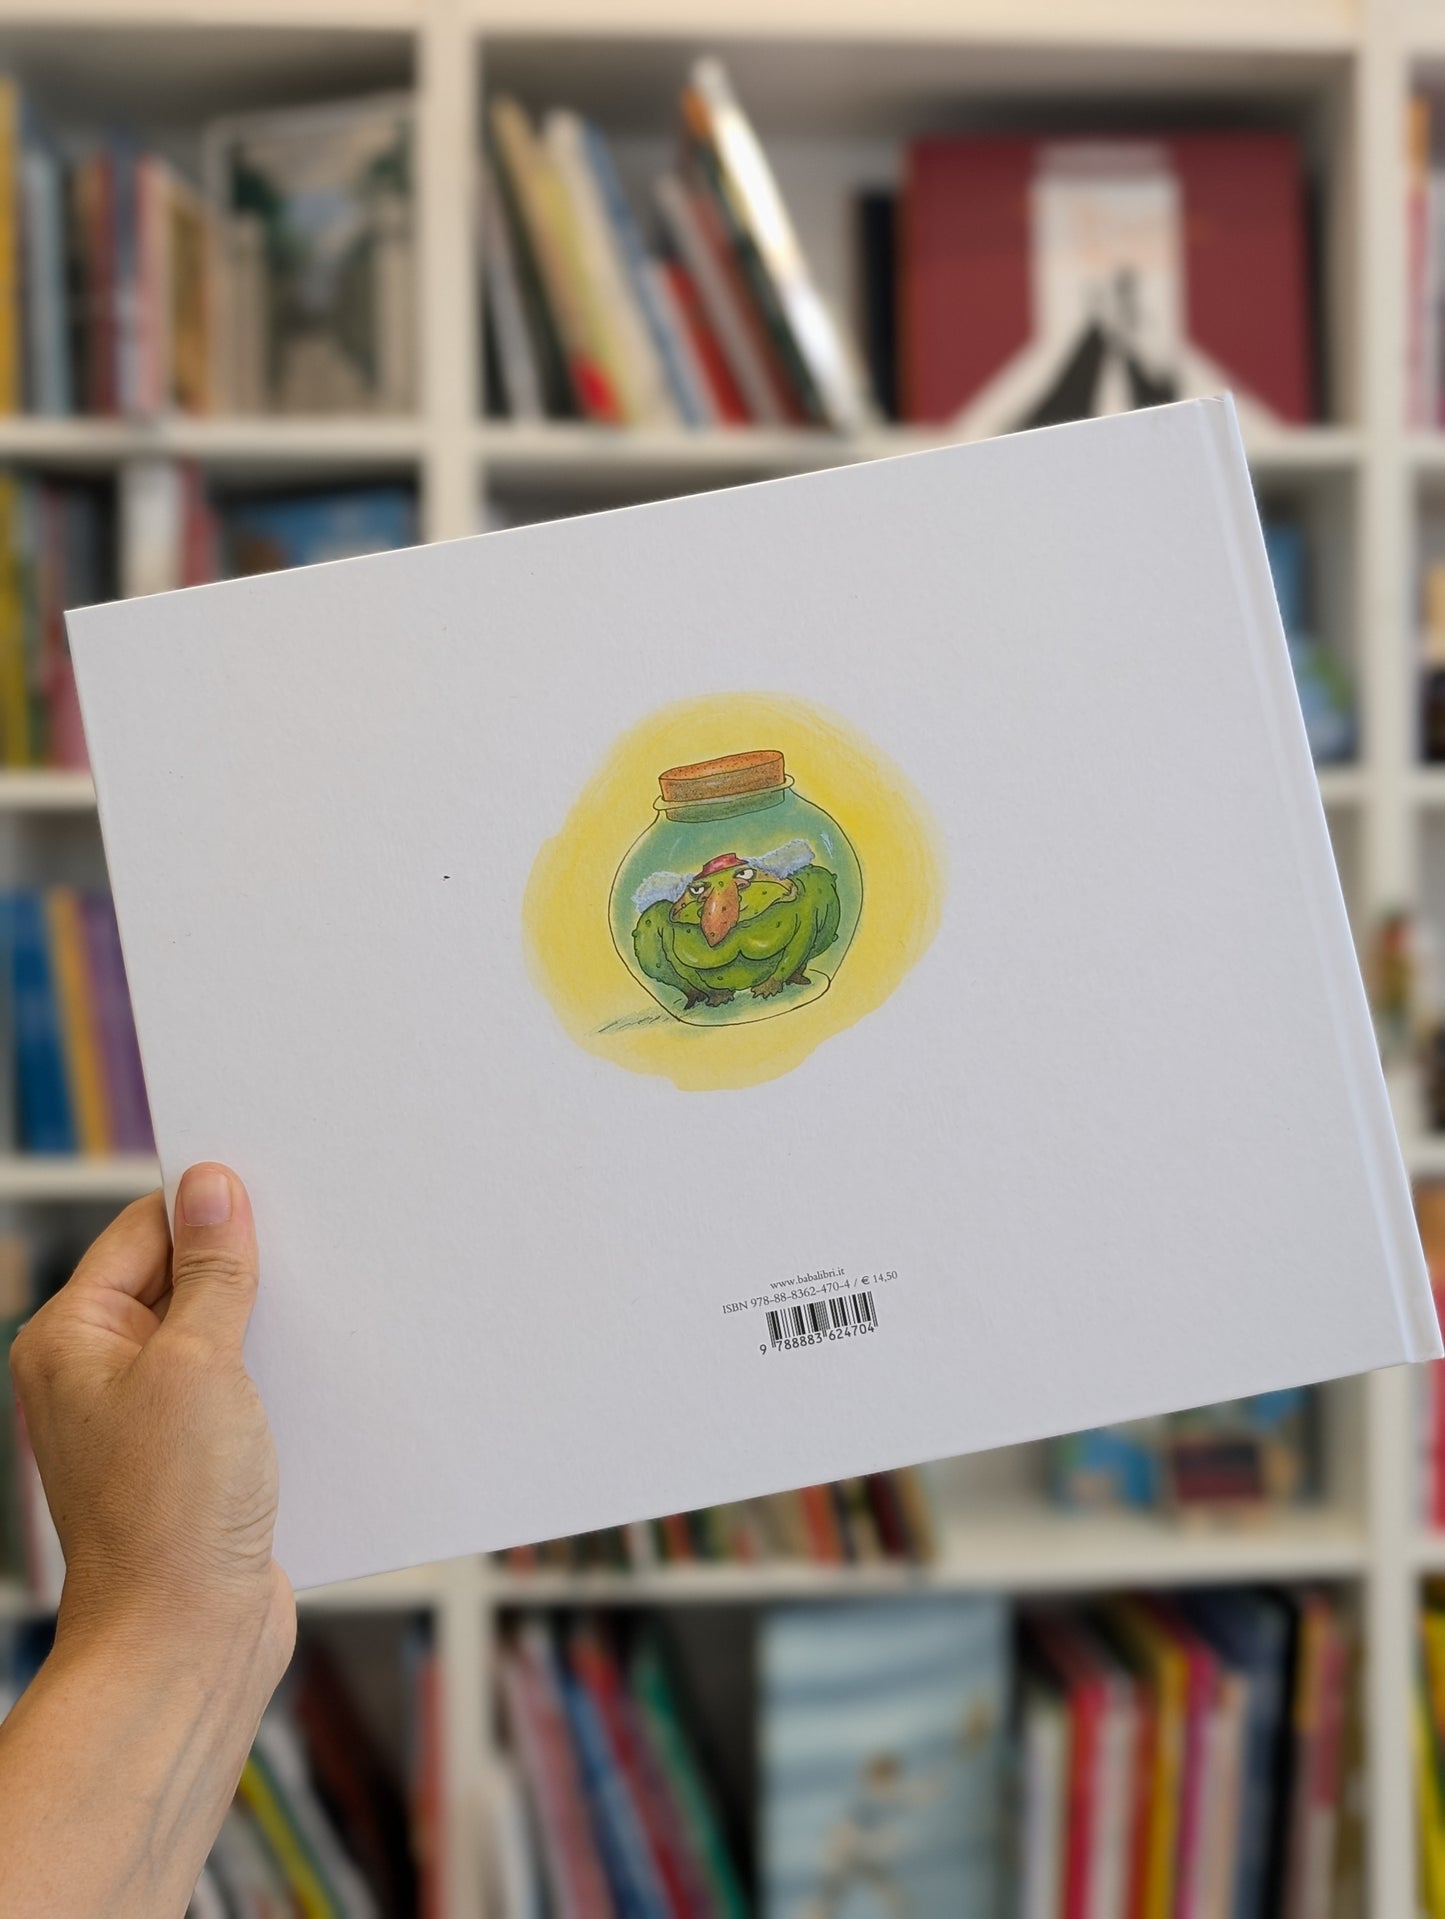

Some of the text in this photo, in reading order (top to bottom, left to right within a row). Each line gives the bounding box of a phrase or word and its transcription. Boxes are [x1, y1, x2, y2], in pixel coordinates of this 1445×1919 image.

[722, 1300, 749, 1314] ISBN
[750, 1279, 850, 1309] 978-88-8362-470-4
[861, 1275, 871, 1285] €
[873, 1270, 898, 1284] 14,50
[769, 1267, 845, 1290] www.babalibri.it
[759, 1323, 875, 1355] 9 788883 624704
